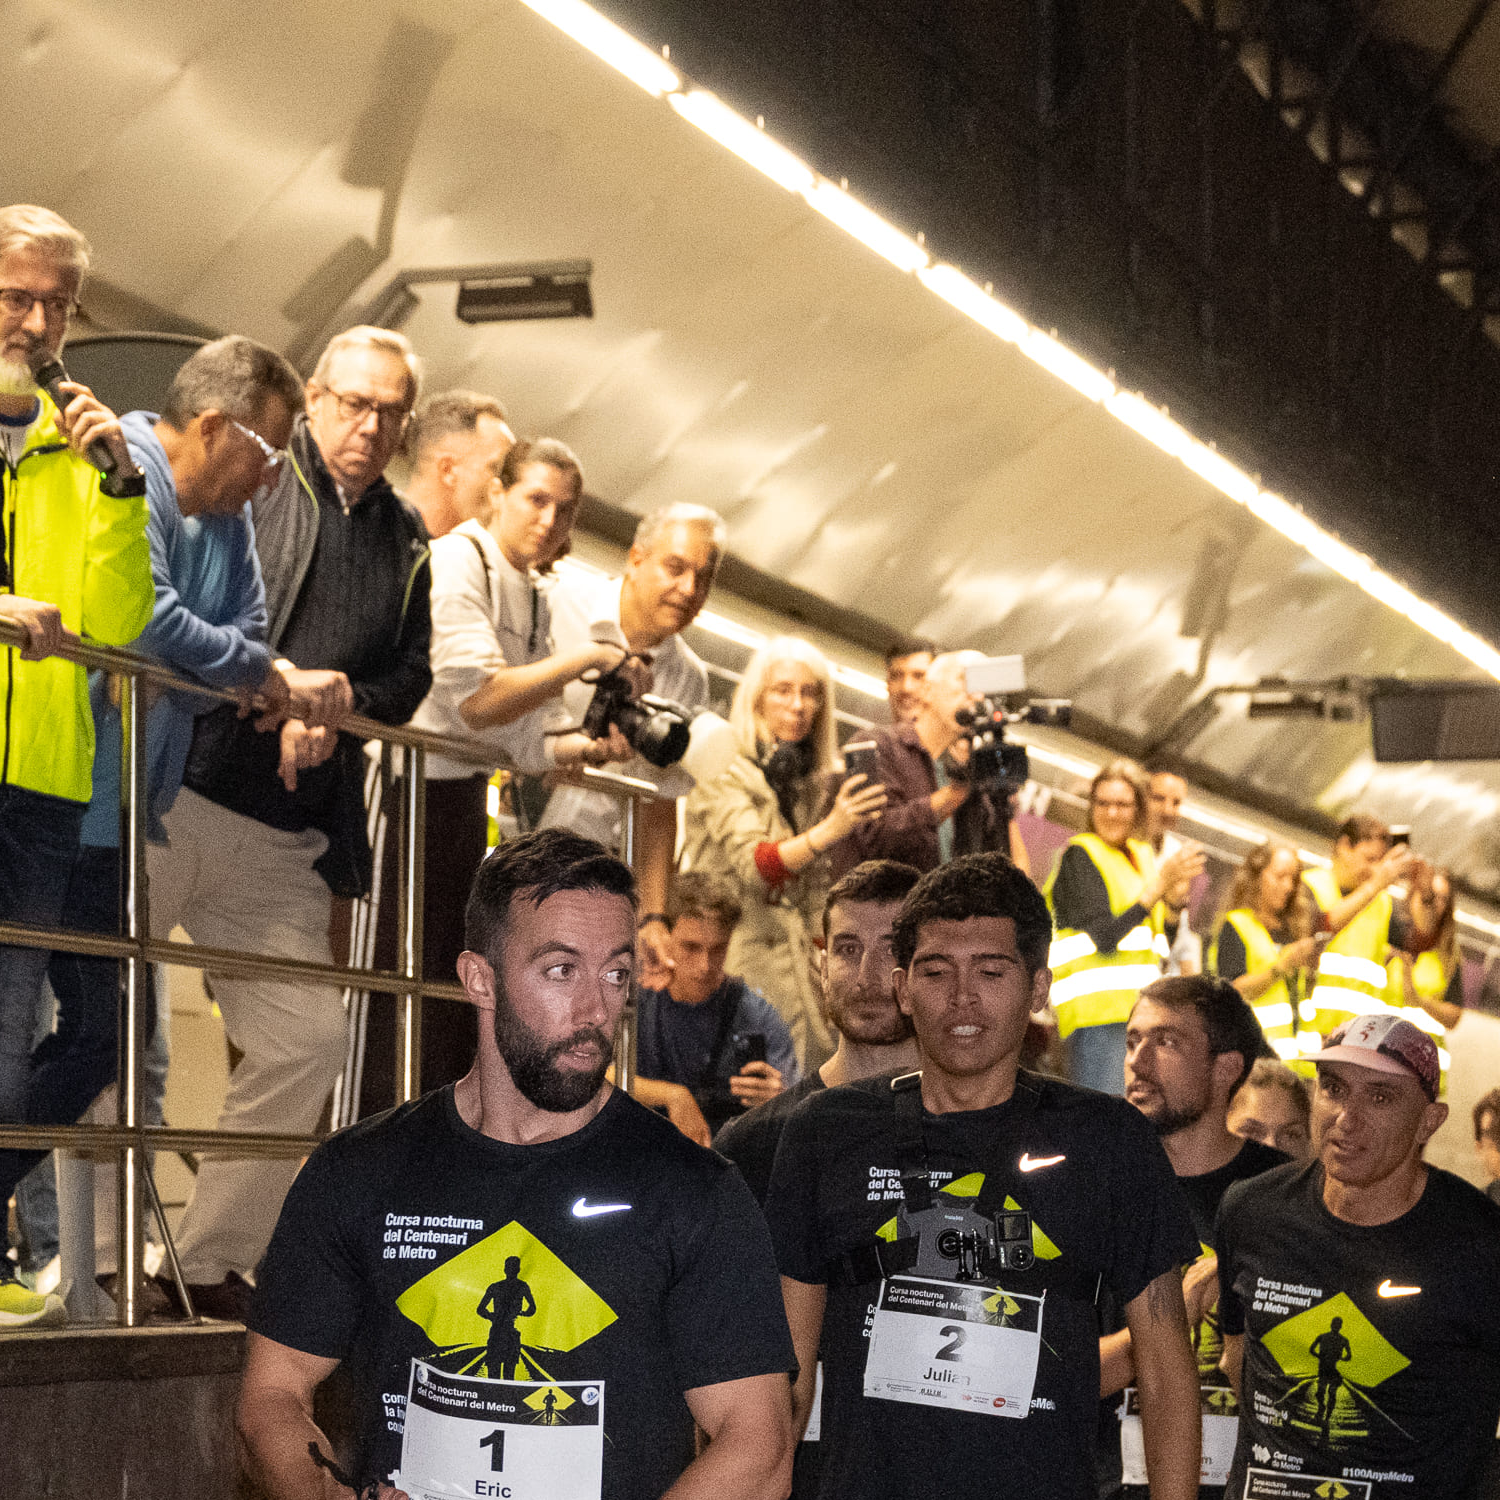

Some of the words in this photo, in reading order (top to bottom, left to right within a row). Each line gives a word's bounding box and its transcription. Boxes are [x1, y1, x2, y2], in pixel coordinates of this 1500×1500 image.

[869, 1167, 900, 1178] Cursa
[868, 1178, 885, 1189] del
[867, 1191, 881, 1201] de
[883, 1190, 905, 1200] Met
[385, 1213, 420, 1226] Cursa
[423, 1215, 483, 1230] nocturna
[384, 1229, 401, 1242] del
[404, 1229, 468, 1245] Centenari
[383, 1246, 396, 1259] de
[399, 1245, 437, 1260] Metro
[890, 1286, 909, 1296] Cursa
[909, 1289, 944, 1300] nocturna
[1257, 1276, 1281, 1290] Cursa
[1283, 1283, 1322, 1298] nocturna
[888, 1295, 899, 1303] del
[899, 1296, 934, 1307] Centenari
[936, 1301, 949, 1309] del
[1255, 1289, 1268, 1300] del
[1269, 1290, 1311, 1307] Centenari
[1252, 1300, 1262, 1311] de
[1263, 1301, 1290, 1315] Metro
[935, 1325, 967, 1362] 2
[417, 1386, 427, 1396] del
[428, 1390, 468, 1407] Centenari
[469, 1400, 484, 1410] del
[486, 1402, 516, 1413] Metro
[437, 1385, 478, 1399] nocturna
[384, 1405, 395, 1417] la
[479, 1429, 505, 1472] 1
[1273, 1451, 1287, 1462] Cent
[1288, 1454, 1304, 1465] anys
[1272, 1460, 1280, 1468] de
[1280, 1461, 1301, 1471] Metro
[1342, 1467, 1414, 1483] #100AnysMetro
[475, 1480, 512, 1498] Eric
[1292, 1490, 1311, 1499] Metro
